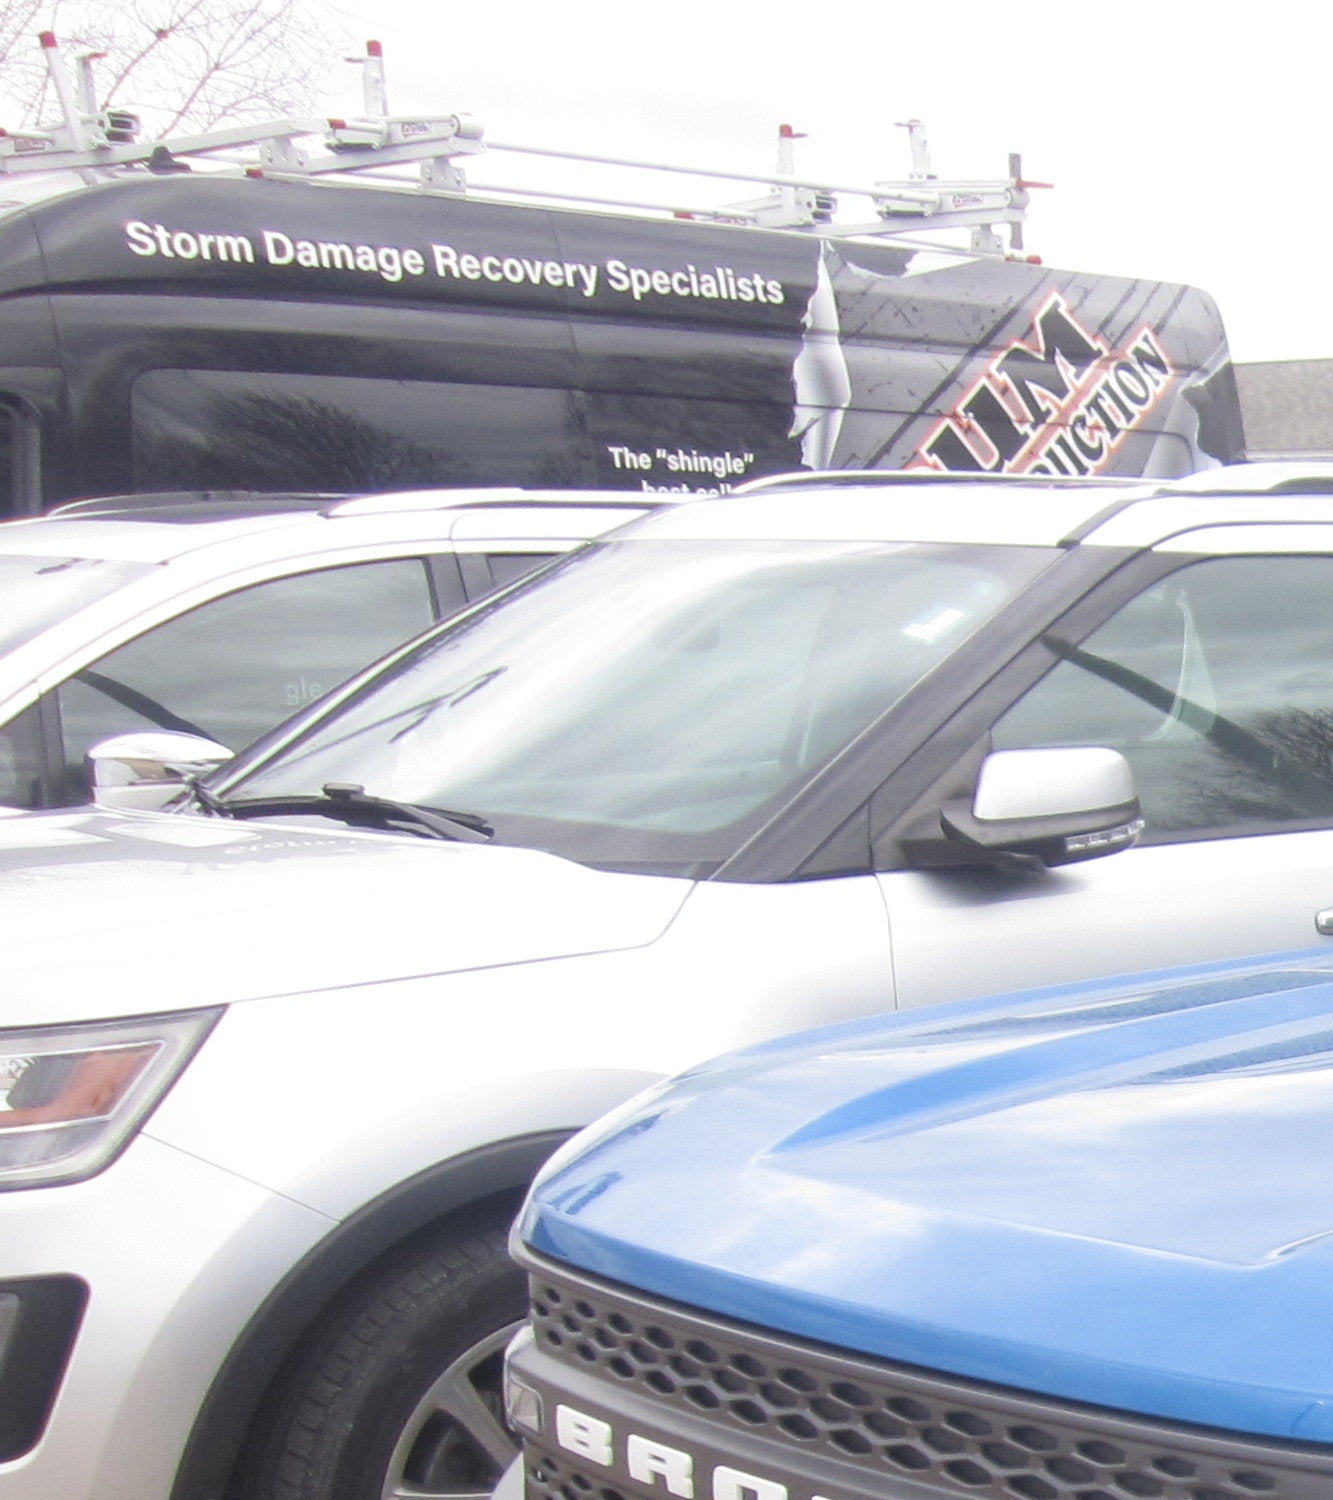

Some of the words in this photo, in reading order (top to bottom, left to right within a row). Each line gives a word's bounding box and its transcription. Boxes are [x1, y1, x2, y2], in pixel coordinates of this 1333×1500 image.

[124, 219, 256, 263] Storm
[261, 229, 426, 283] Damage
[430, 243, 598, 298] Recovery
[604, 259, 786, 305] Specialists
[606, 445, 653, 470] The
[655, 447, 755, 479] "shingle"
